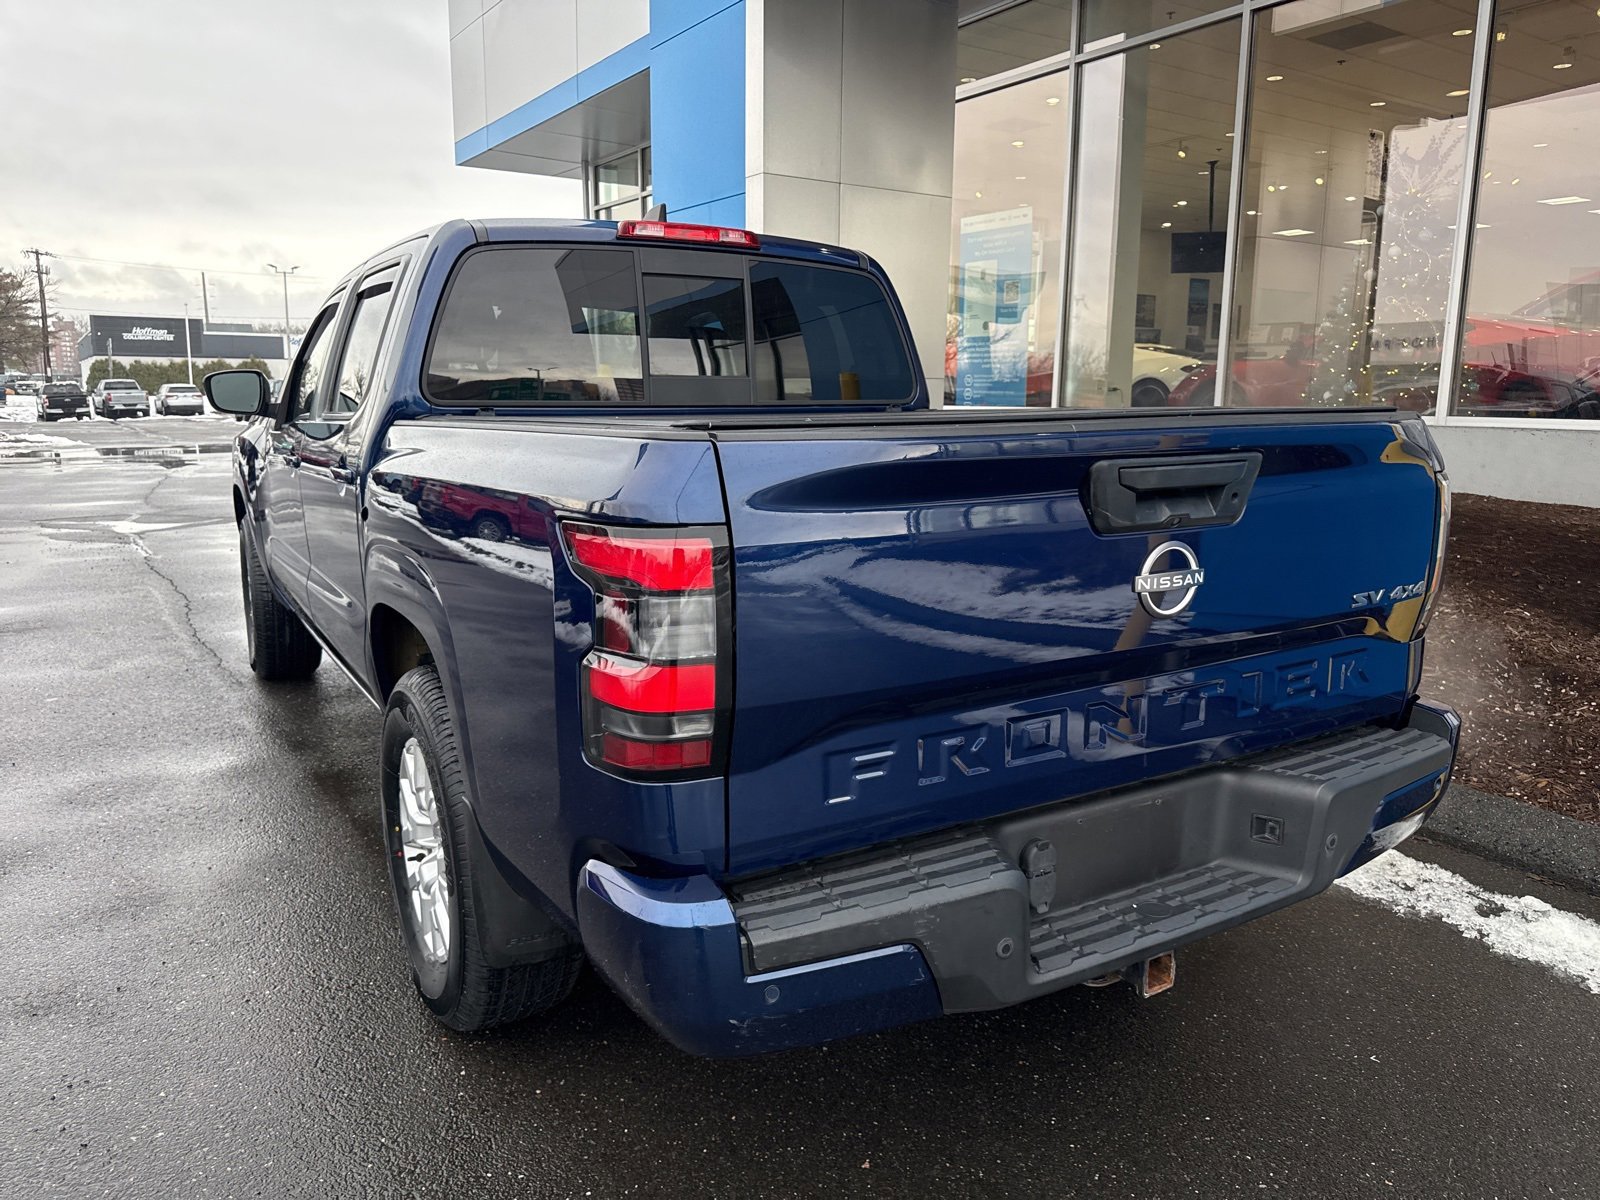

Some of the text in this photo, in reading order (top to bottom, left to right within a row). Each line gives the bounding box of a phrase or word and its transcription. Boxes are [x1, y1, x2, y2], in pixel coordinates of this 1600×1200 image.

[131, 326, 168, 335] Hoffman
[1137, 571, 1204, 591] NISSAN
[1351, 588, 1386, 609] SV
[821, 647, 1371, 808] FRONTIER
